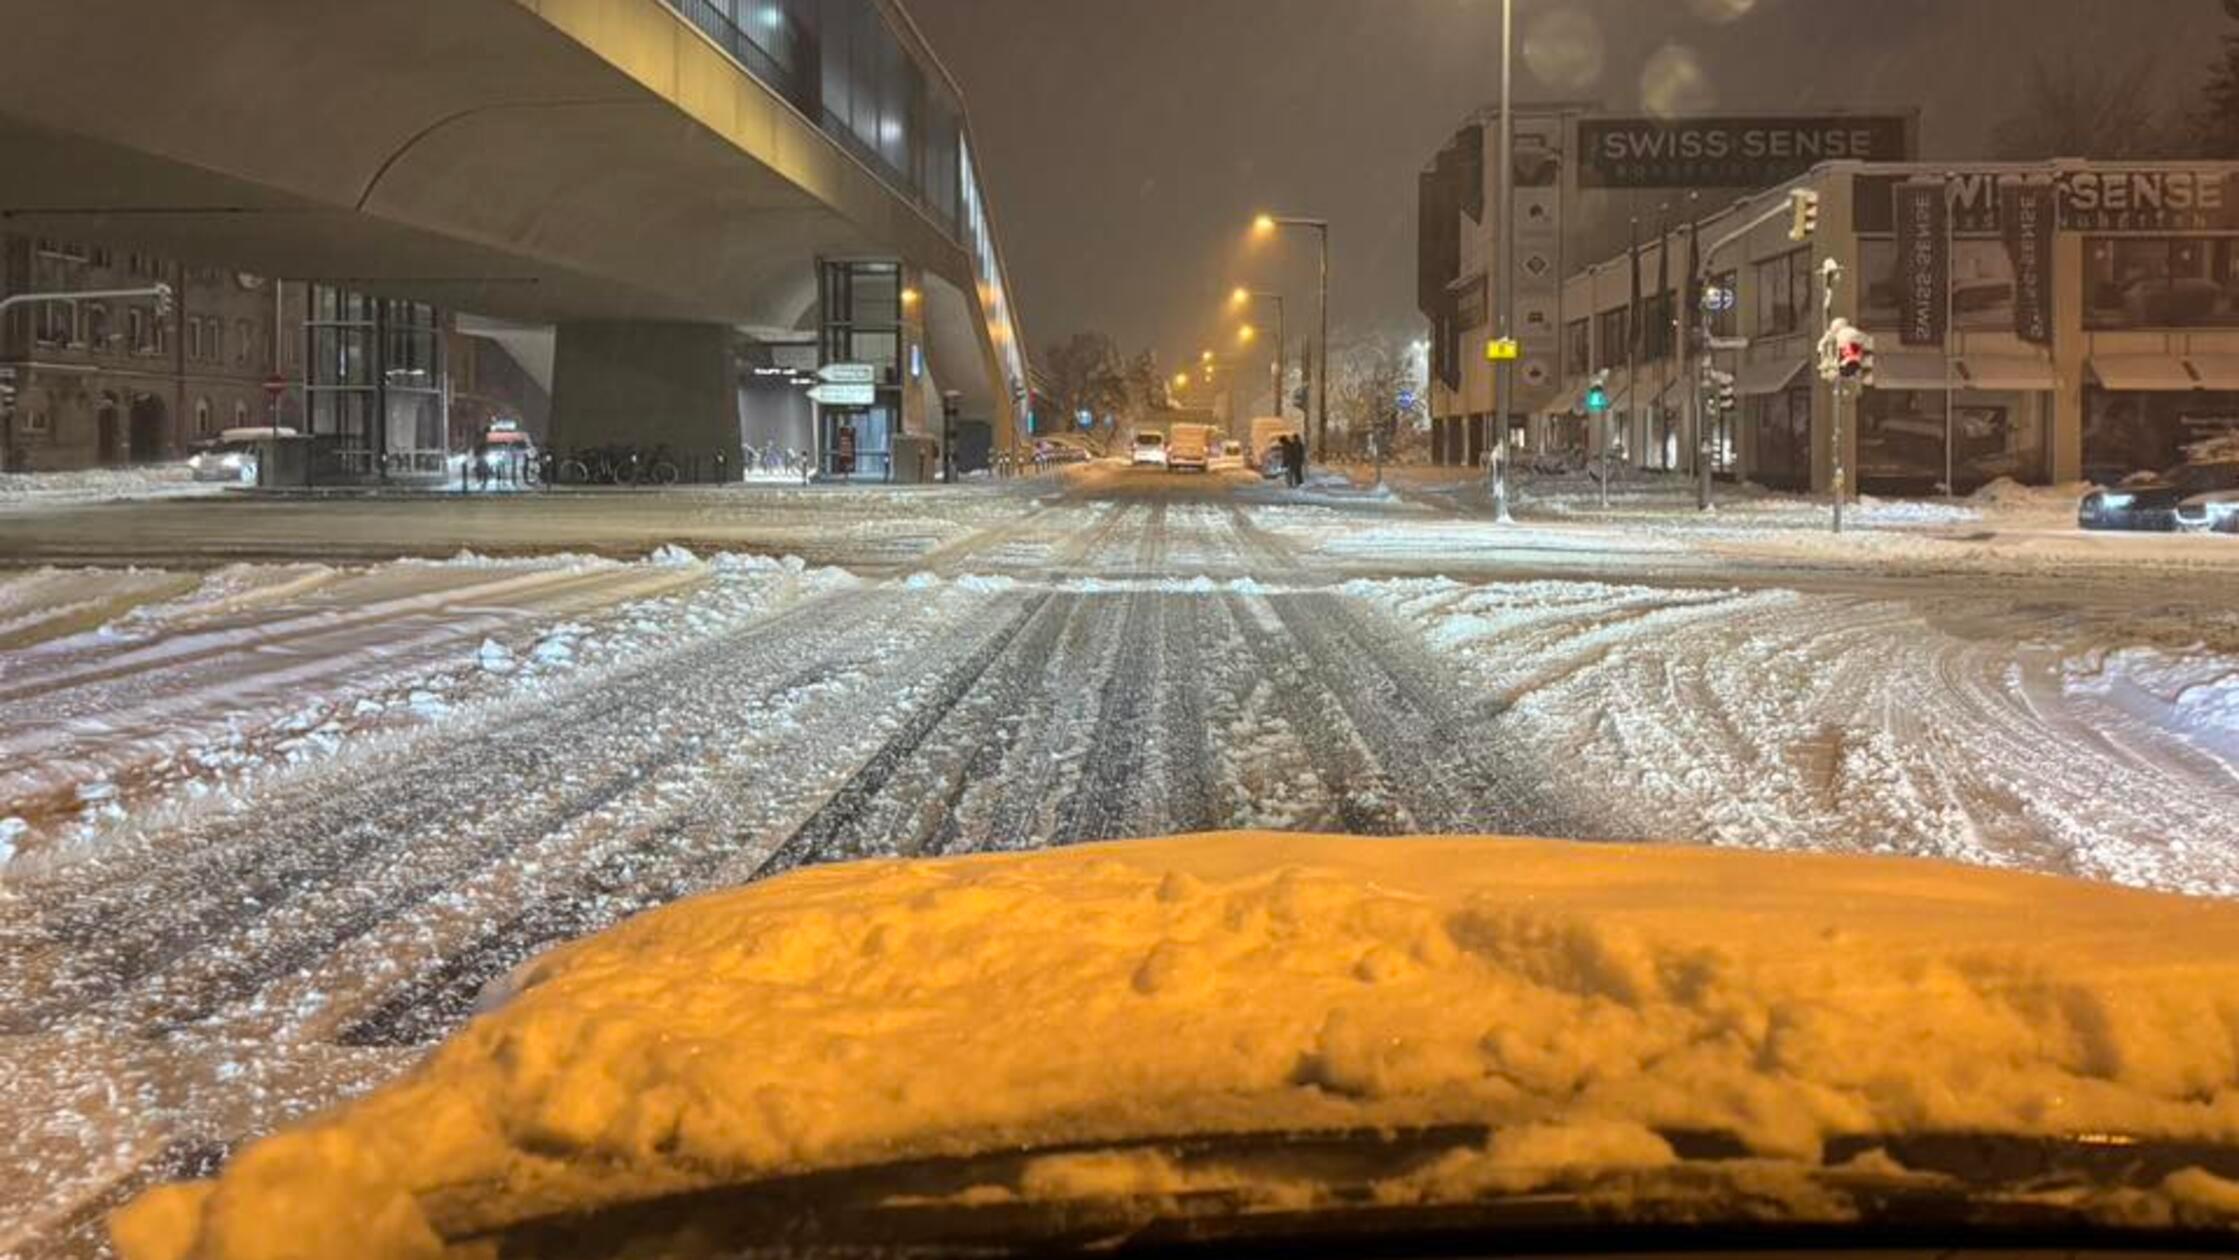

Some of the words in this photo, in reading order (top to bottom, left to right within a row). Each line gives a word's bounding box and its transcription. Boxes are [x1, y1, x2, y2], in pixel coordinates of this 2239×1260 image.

[1604, 130, 1727, 158] SWISS
[1743, 129, 1871, 156] SENSE
[2069, 173, 2222, 209] SENSE
